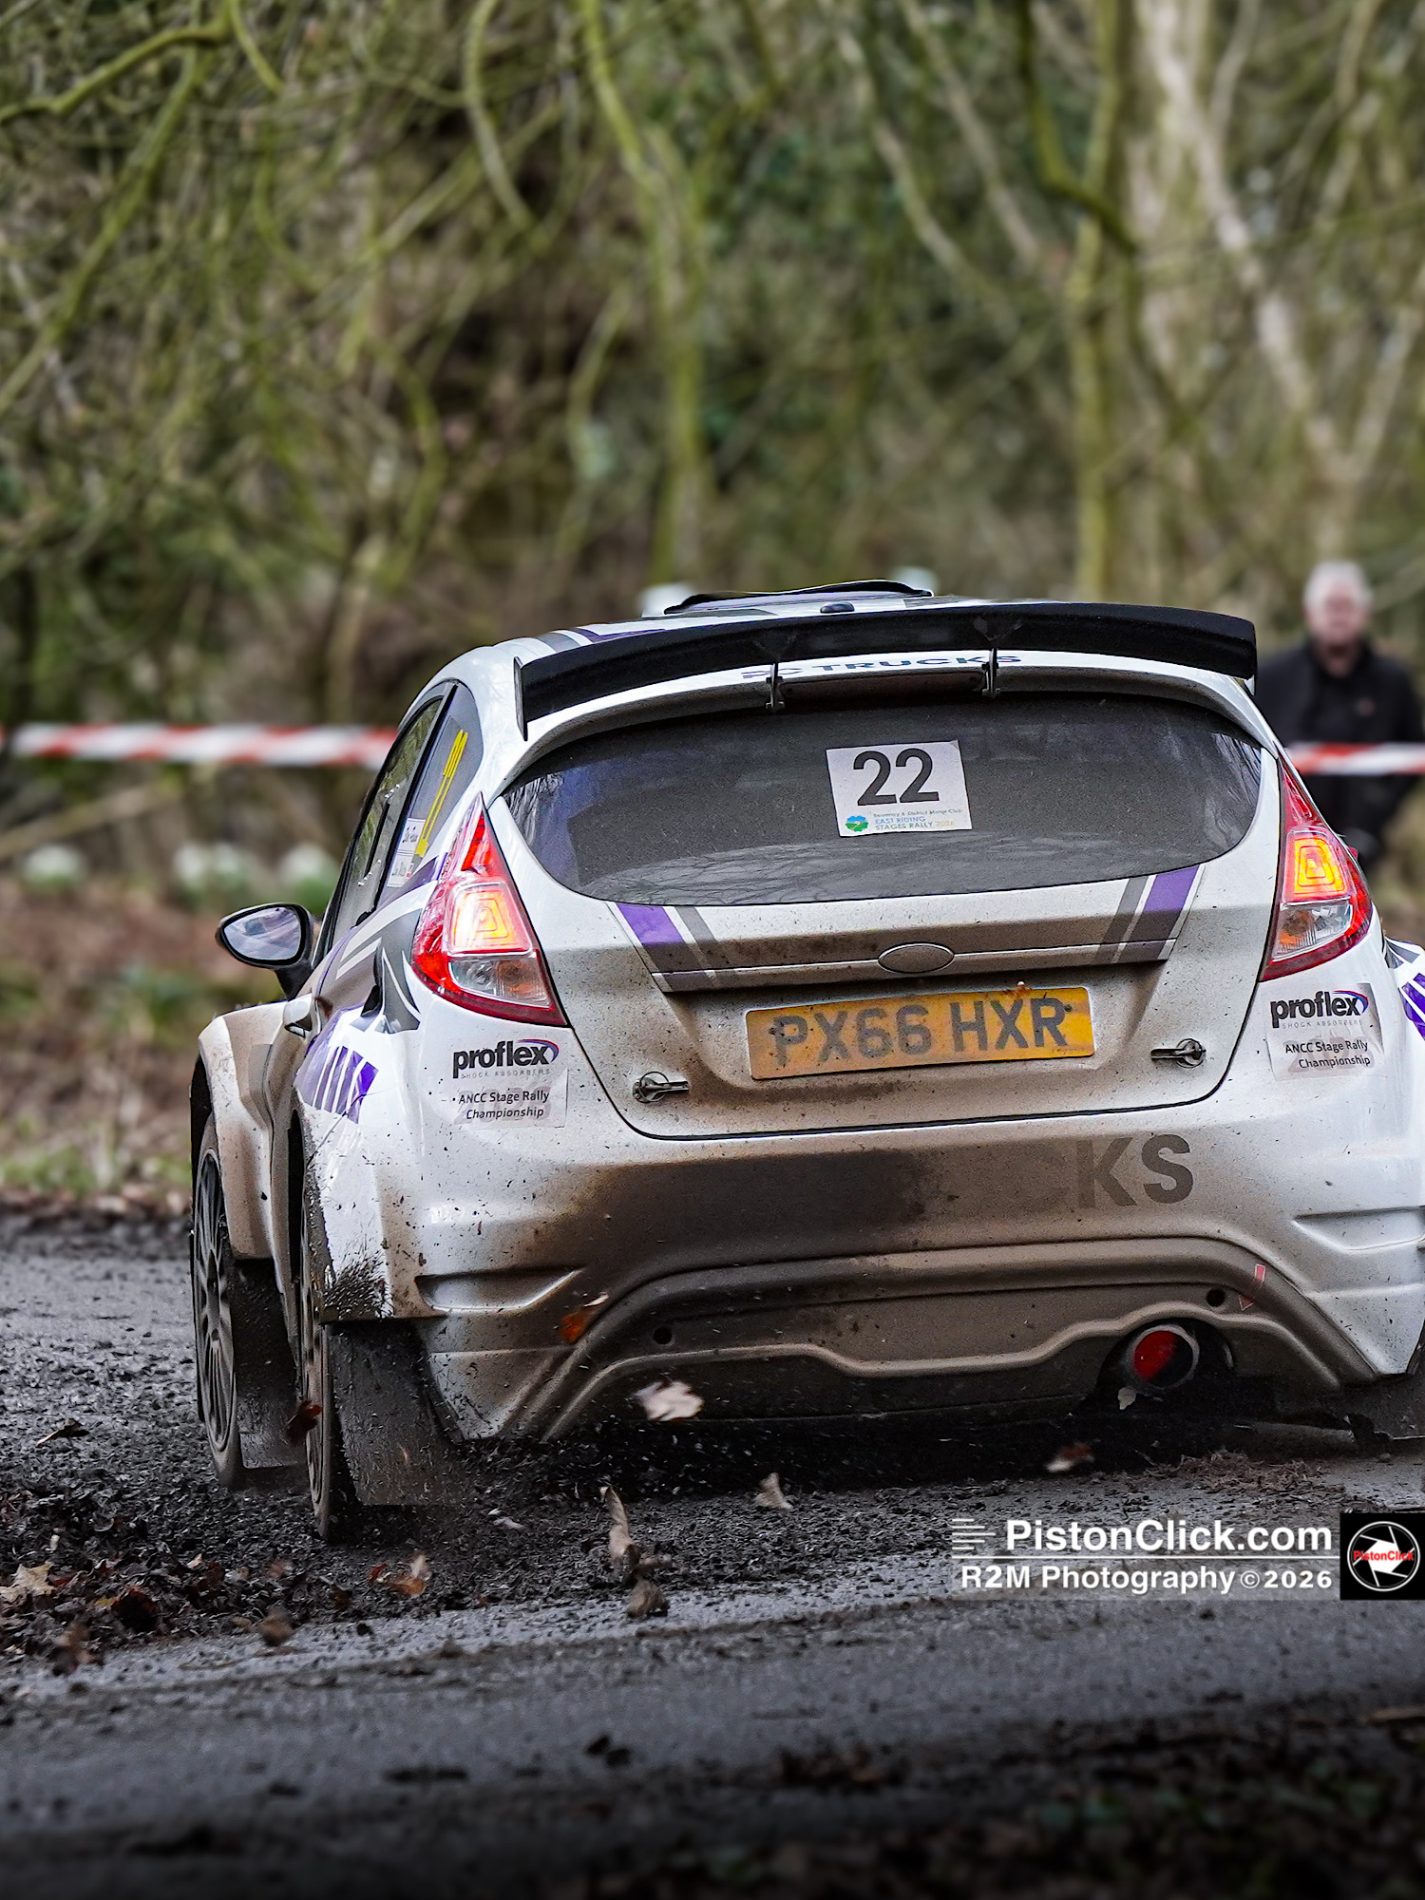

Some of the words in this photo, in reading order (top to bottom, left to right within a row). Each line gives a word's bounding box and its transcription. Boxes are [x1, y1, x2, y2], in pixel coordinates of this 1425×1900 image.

[853, 747, 940, 806] 22
[1270, 991, 1361, 1028] proflex
[773, 1004, 933, 1066] PX66
[949, 997, 1069, 1052] HXR
[453, 1040, 550, 1079] proflex
[1285, 1041, 1313, 1054] ANCC
[1316, 1040, 1344, 1054] Stage
[1345, 1039, 1369, 1051] Rally
[1298, 1055, 1371, 1069] Championship
[458, 1093, 487, 1105] ANCC
[489, 1091, 520, 1105] Stage
[522, 1090, 550, 1105] Rally
[466, 1106, 545, 1122] Championship
